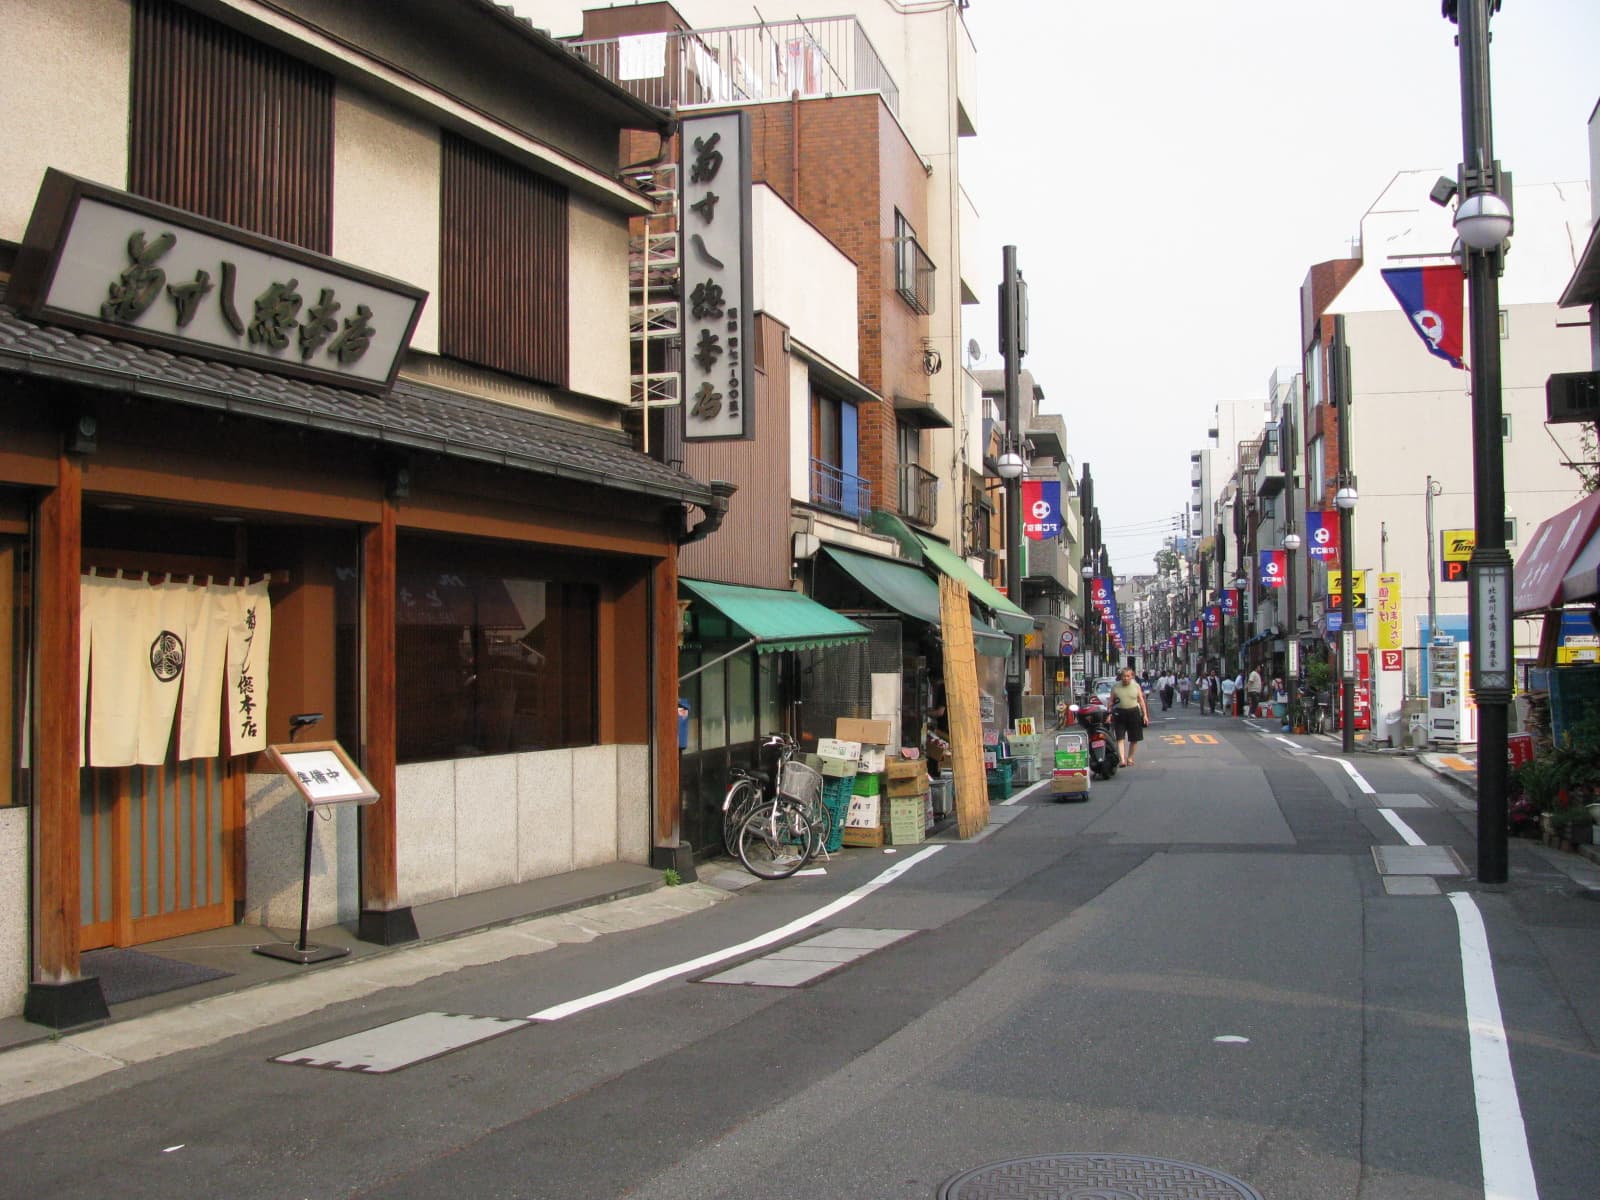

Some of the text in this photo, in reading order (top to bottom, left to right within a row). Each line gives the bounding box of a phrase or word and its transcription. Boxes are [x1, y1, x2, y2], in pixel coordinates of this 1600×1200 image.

[1448, 562, 1462, 580] P
[1332, 595, 1342, 608] P
[1018, 723, 1032, 737] 100
[1160, 733, 1220, 746] 30
[297, 768, 340, 785] 準備中
